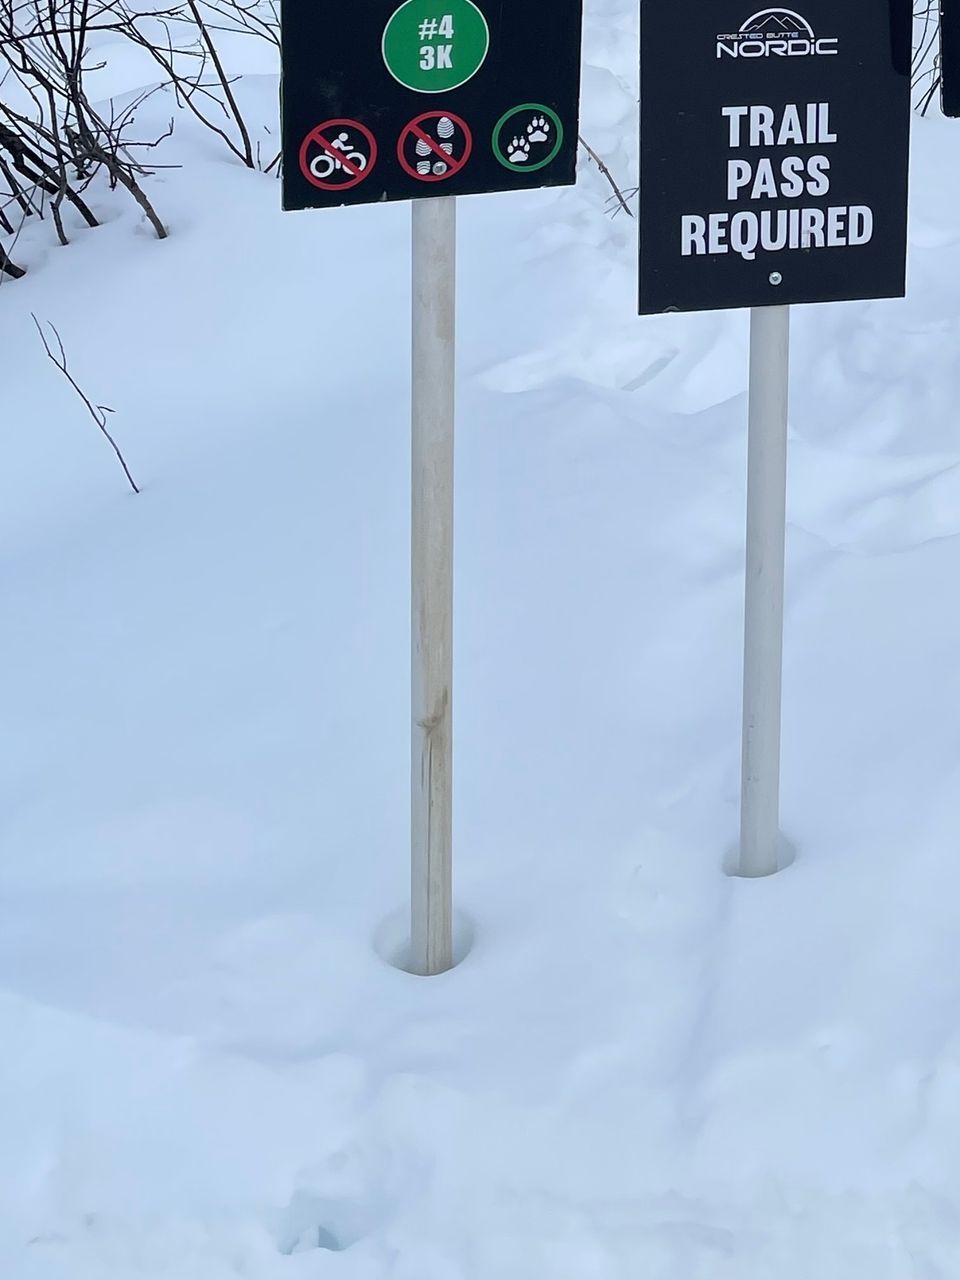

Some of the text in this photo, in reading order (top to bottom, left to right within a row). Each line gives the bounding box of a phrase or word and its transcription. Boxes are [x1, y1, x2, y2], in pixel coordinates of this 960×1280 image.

[418, 15, 454, 40] #4
[766, 31, 799, 39] BUTTE
[419, 45, 453, 70] 3K
[721, 102, 837, 147] TRAIL
[727, 155, 830, 200] PASS
[681, 205, 873, 260] REQUIRED
